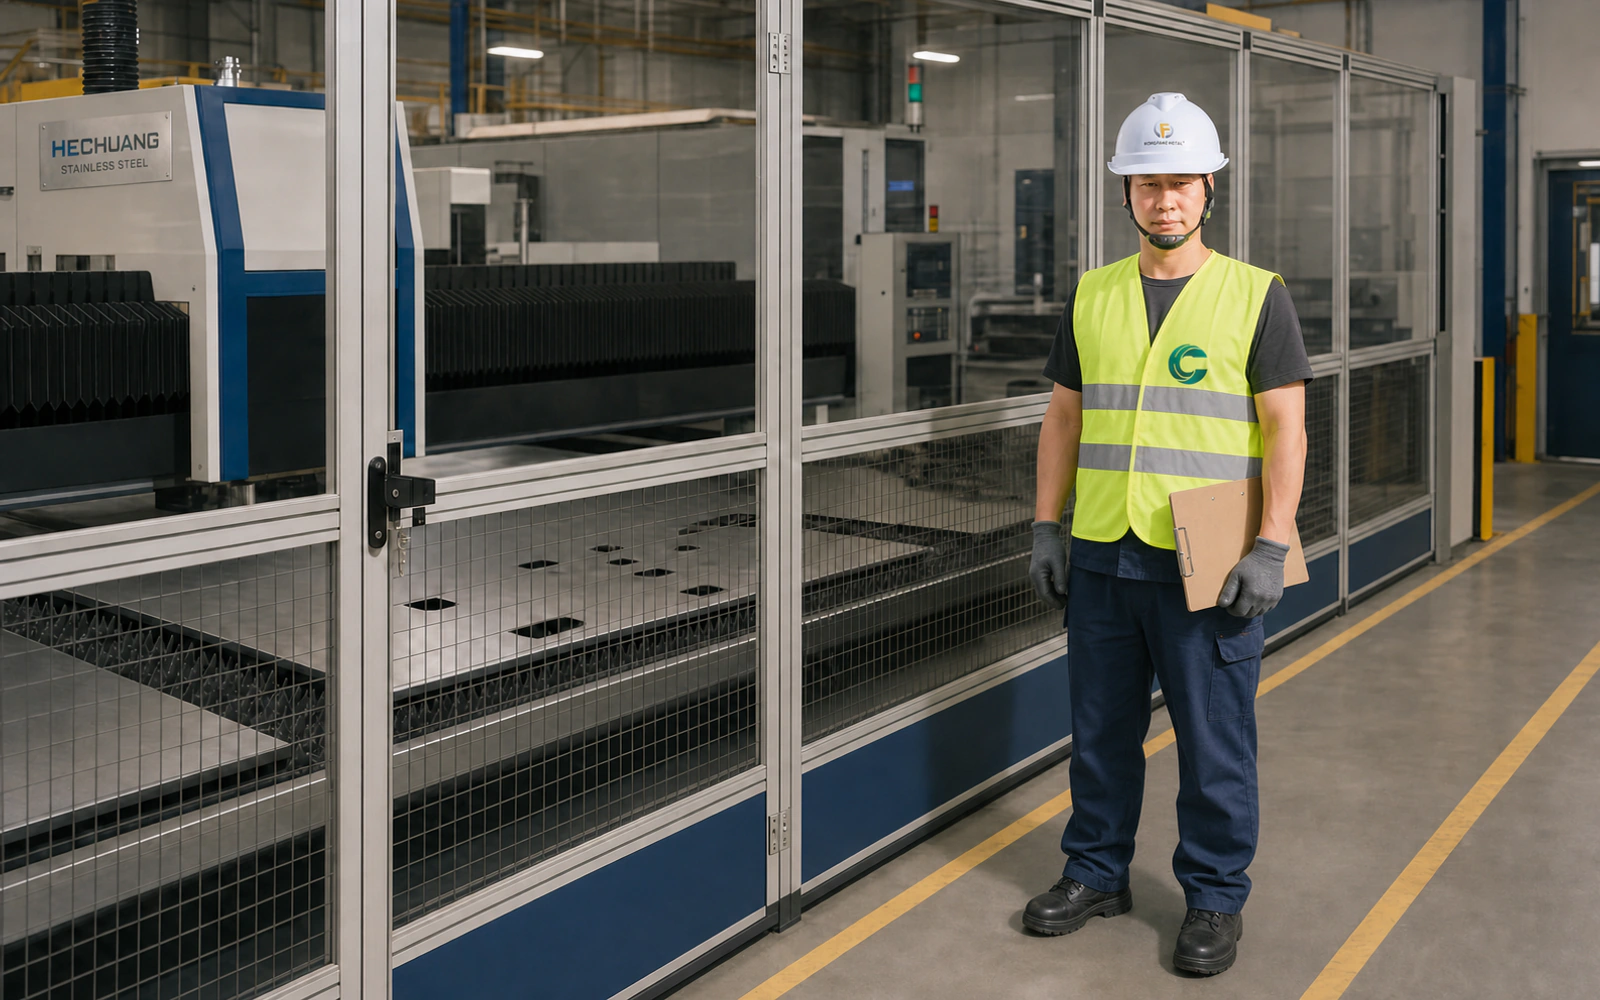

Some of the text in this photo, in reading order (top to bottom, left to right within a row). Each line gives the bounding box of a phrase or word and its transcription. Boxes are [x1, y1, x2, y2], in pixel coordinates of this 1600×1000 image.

[52, 132, 159, 158] HECHUANG
[61, 158, 148, 175] STAINLESS STEEL
